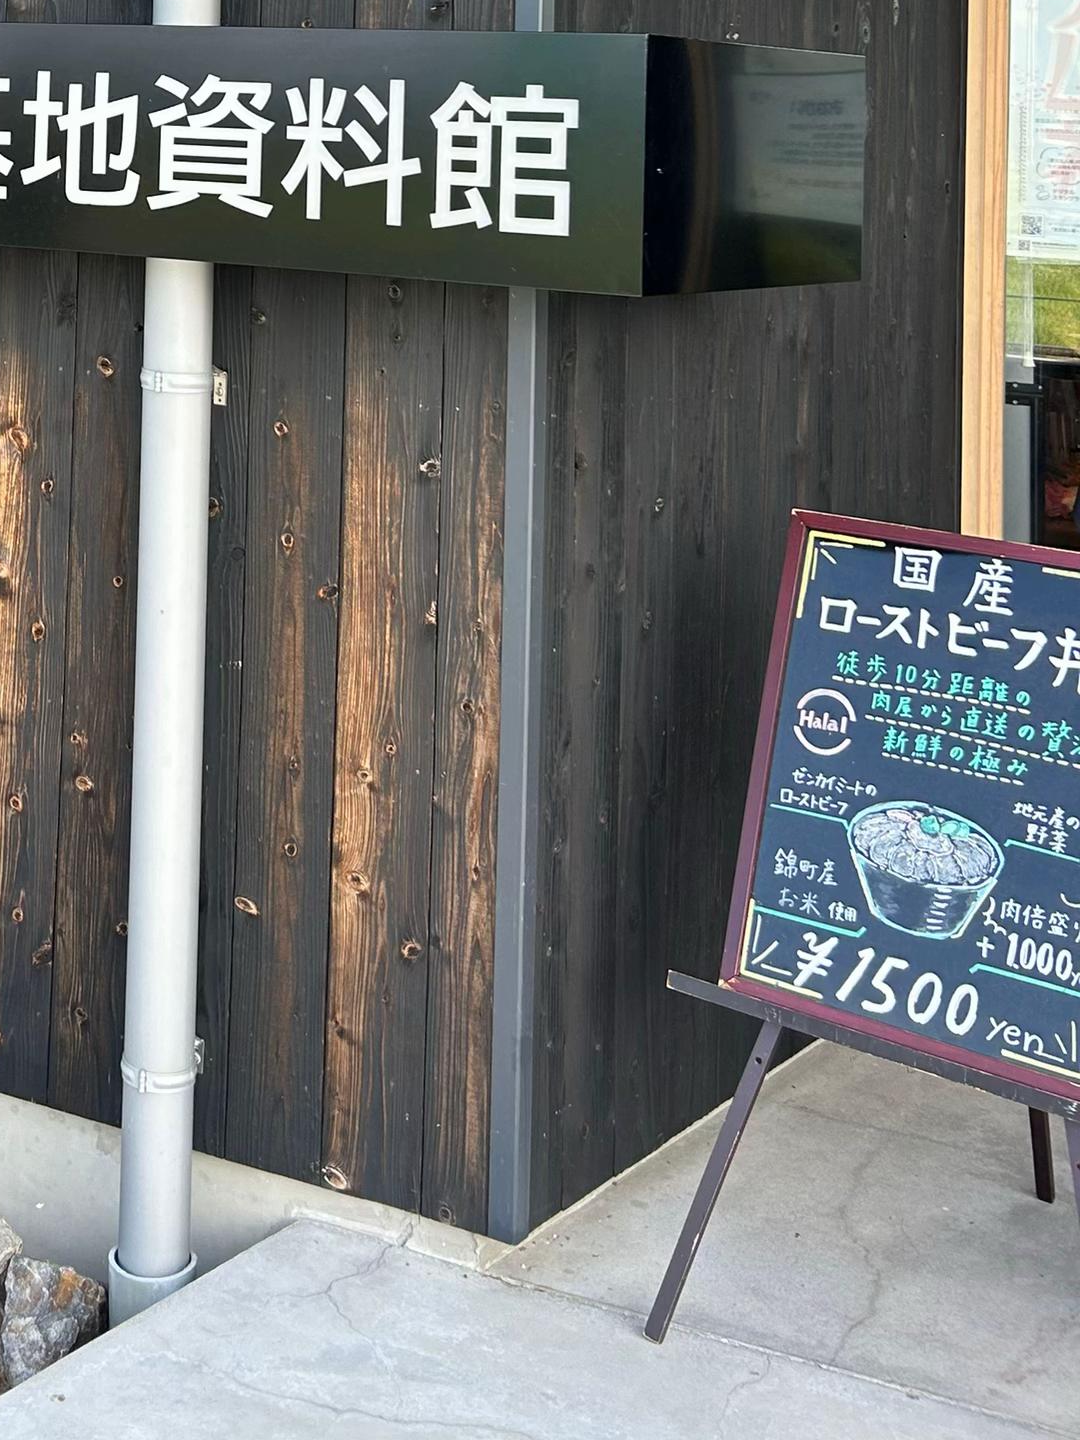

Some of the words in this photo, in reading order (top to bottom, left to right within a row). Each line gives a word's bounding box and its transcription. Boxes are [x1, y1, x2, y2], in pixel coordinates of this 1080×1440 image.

[799, 710, 848, 734] Halal
[882, 726, 1028, 776] 新鮮の極み
[780, 788, 848, 815] ローストビーフ
[1012, 802, 1080, 830] 地元産の
[1025, 823, 1068, 853] 野菜
[774, 848, 838, 886] 錦町産
[986, 1016, 1064, 1062] yen
